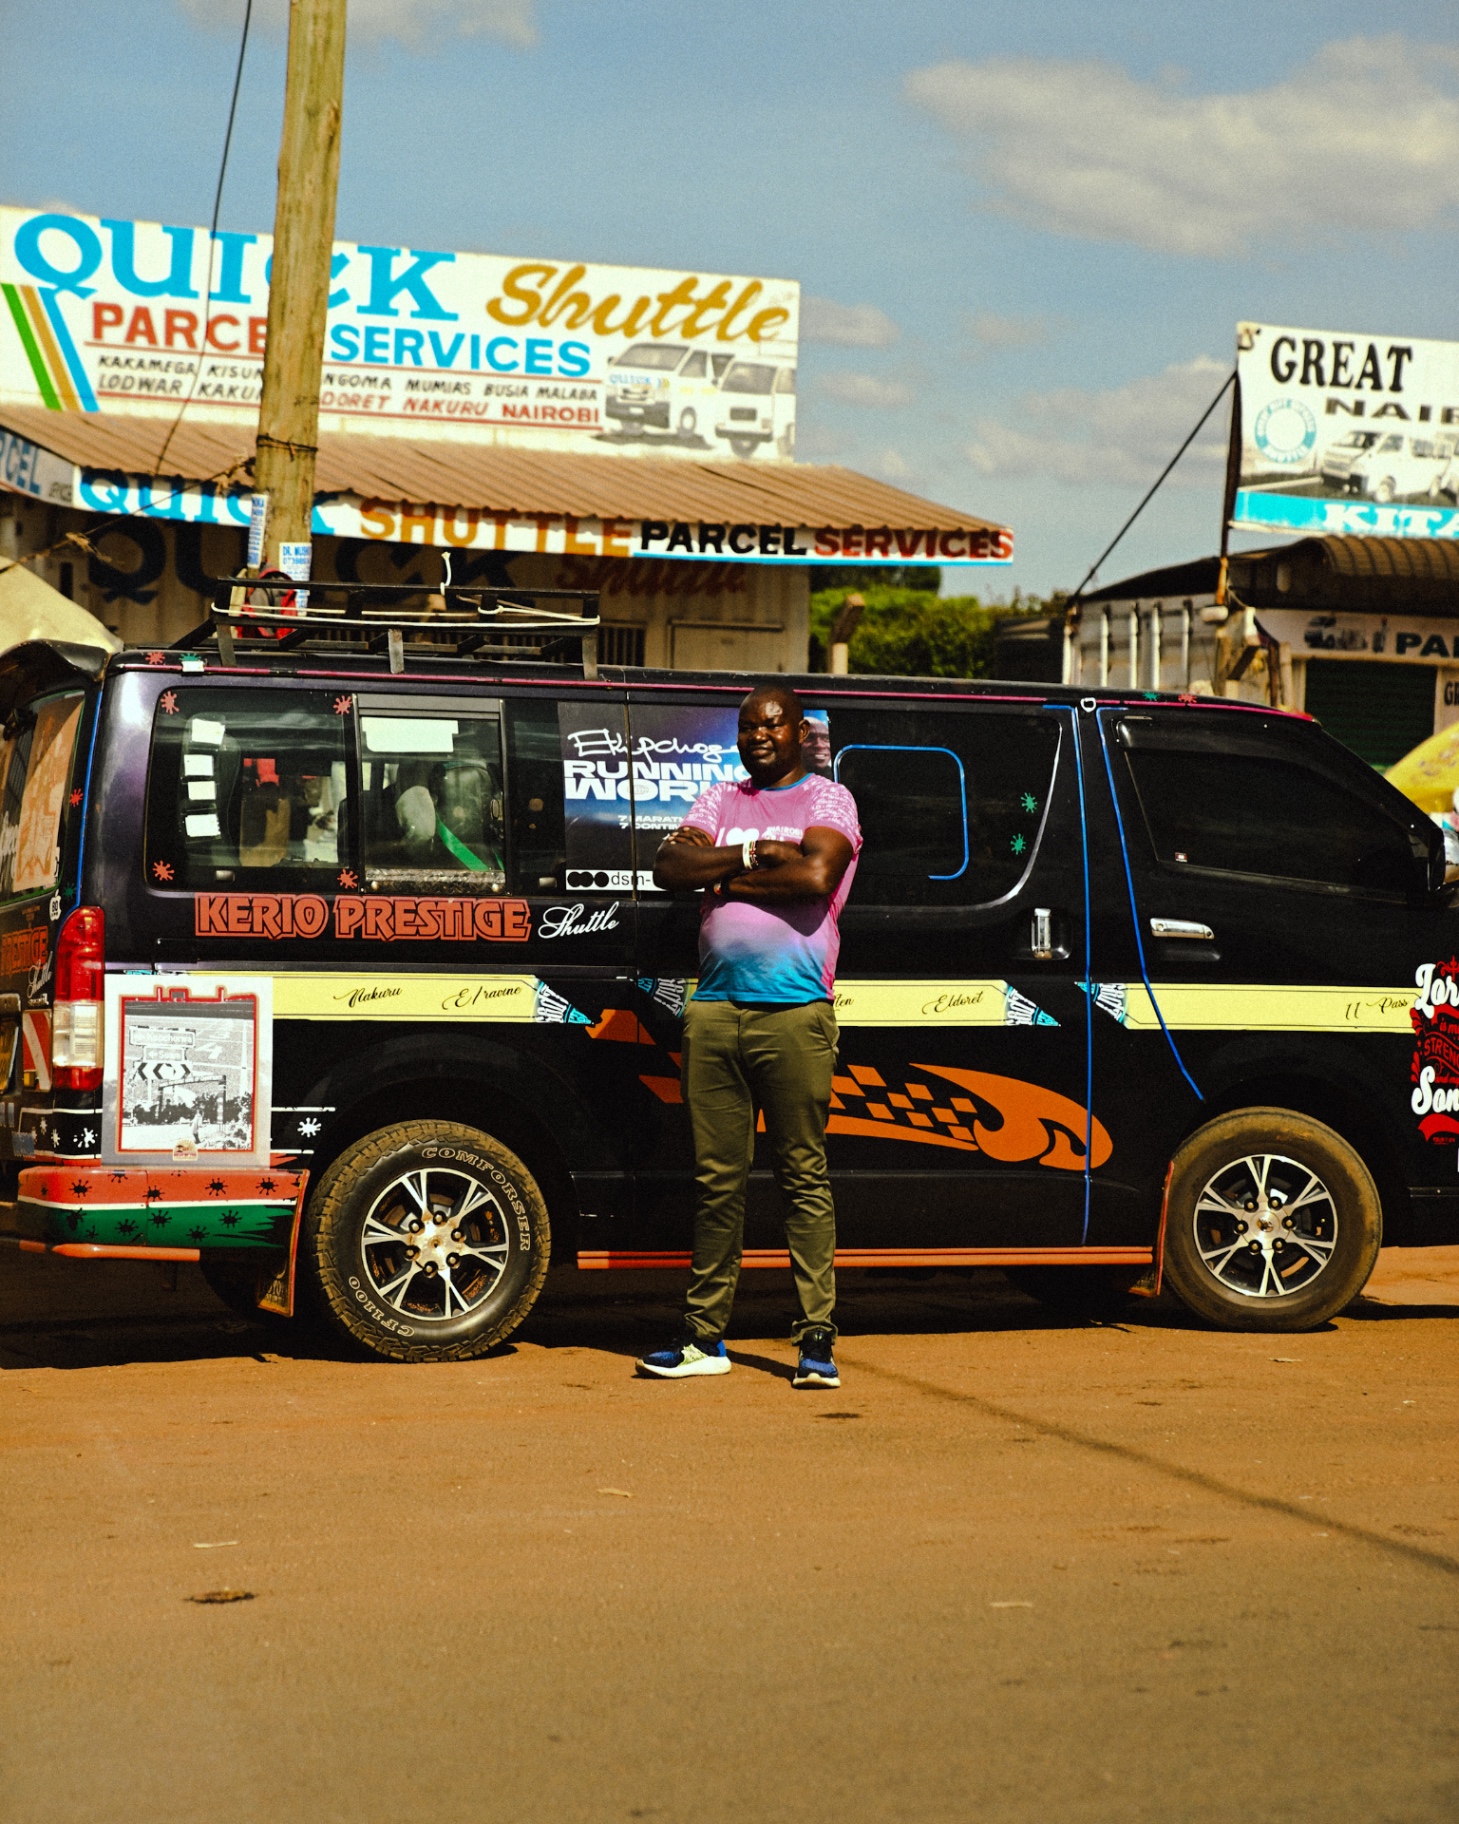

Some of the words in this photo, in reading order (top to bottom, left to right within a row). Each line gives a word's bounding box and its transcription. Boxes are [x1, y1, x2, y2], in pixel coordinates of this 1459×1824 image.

[486, 264, 790, 343] Shuttle
[330, 323, 591, 377] SERVICES
[1270, 335, 1413, 393] GREAT
[98, 373, 183, 395] LODWAR
[198, 381, 262, 401] KAKU
[403, 397, 490, 417] NAKURU
[502, 403, 600, 424] NAIROBI
[99, 355, 197, 375] KAKAMEGA
[405, 378, 472, 395] MUMIAS
[484, 382, 530, 399] BUSIA
[535, 385, 599, 402] MALABA
[79, 468, 335, 535] QUI
[360, 497, 633, 557] SHUTTLE
[641, 520, 807, 556] PARCEL
[814, 527, 1013, 560] SERVICES
[1396, 632, 1459, 658] PA
[197, 893, 328, 940] KERIO
[335, 894, 531, 942] PRESTIGE
[538, 901, 620, 939] Shuttle
[334, 986, 403, 1008] Nakuru
[922, 991, 984, 1015] Eldoret
[421, 1147, 531, 1251] COMFORSER
[348, 1276, 415, 1338] CF1100
